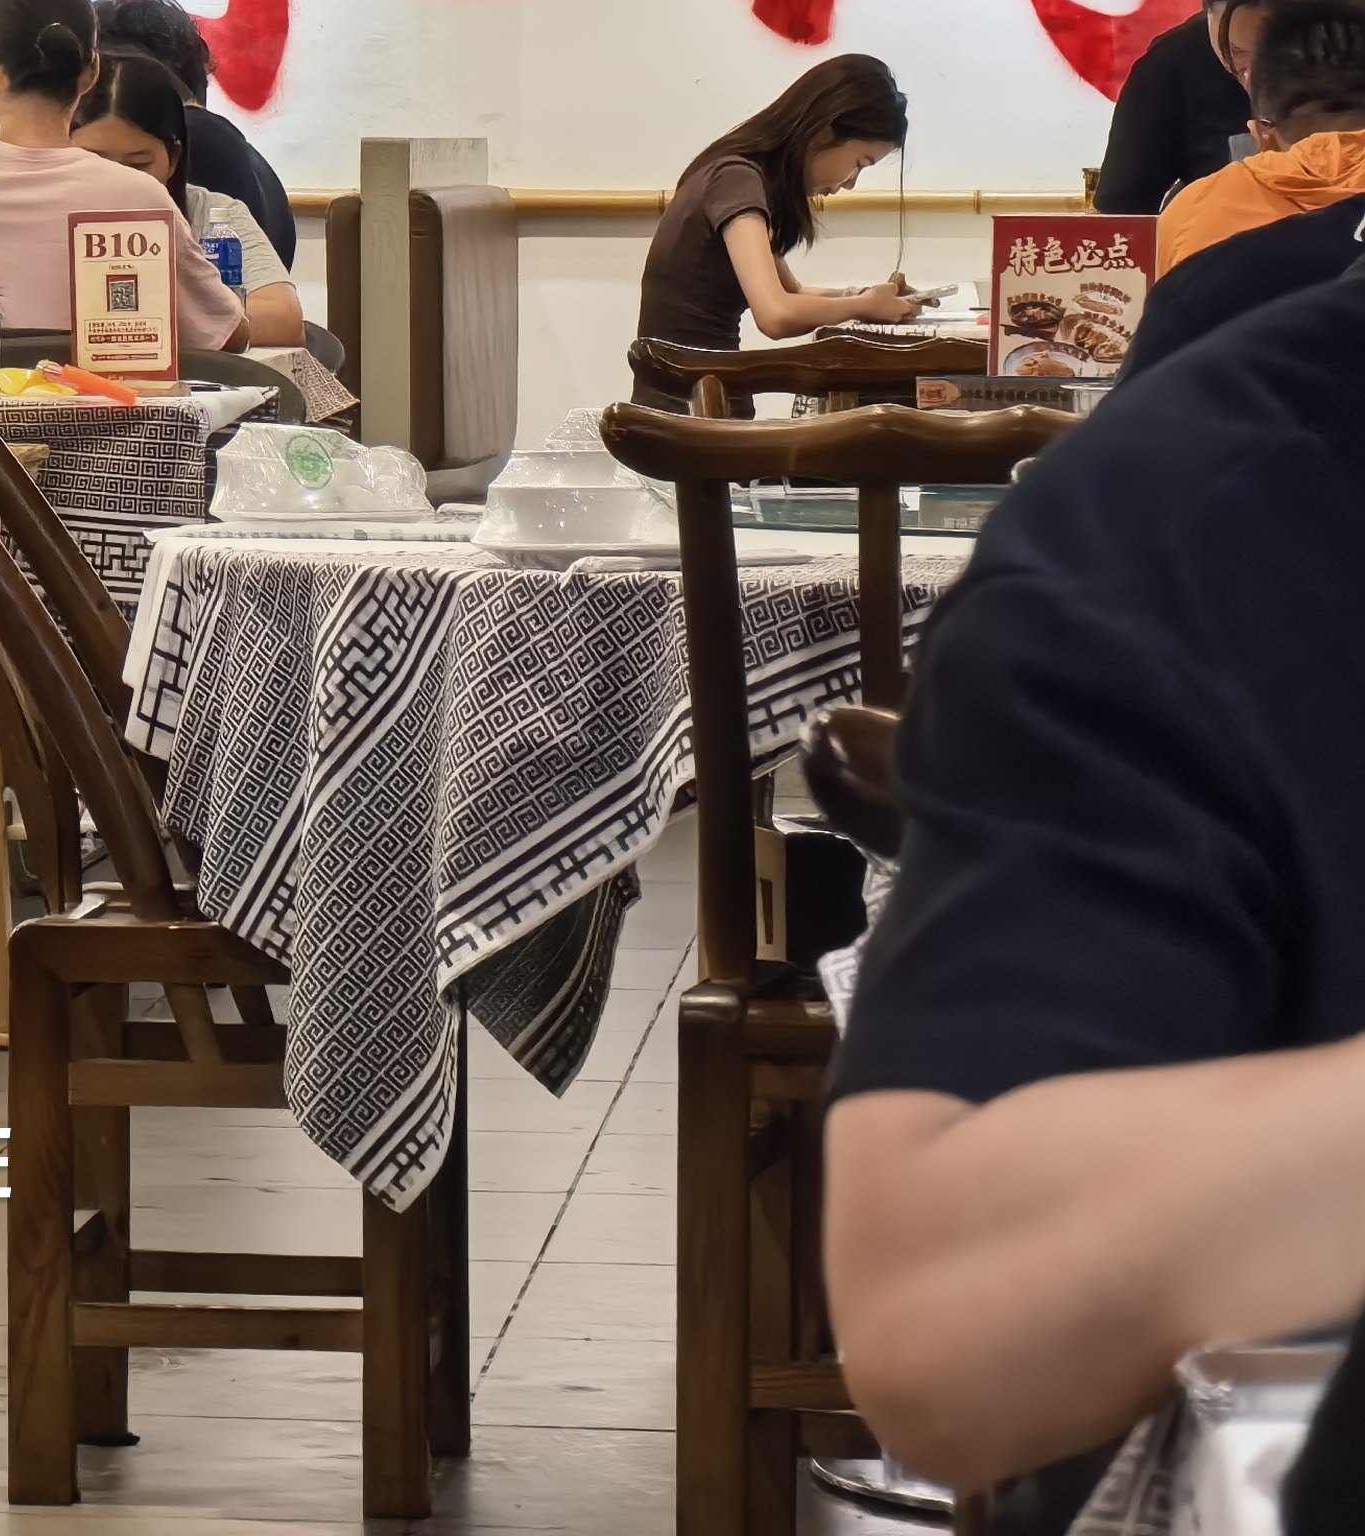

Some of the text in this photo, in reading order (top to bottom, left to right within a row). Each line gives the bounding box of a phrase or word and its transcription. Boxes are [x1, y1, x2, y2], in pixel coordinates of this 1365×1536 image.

[83, 232, 148, 259] B10
[1009, 233, 1135, 276] 特色必点
